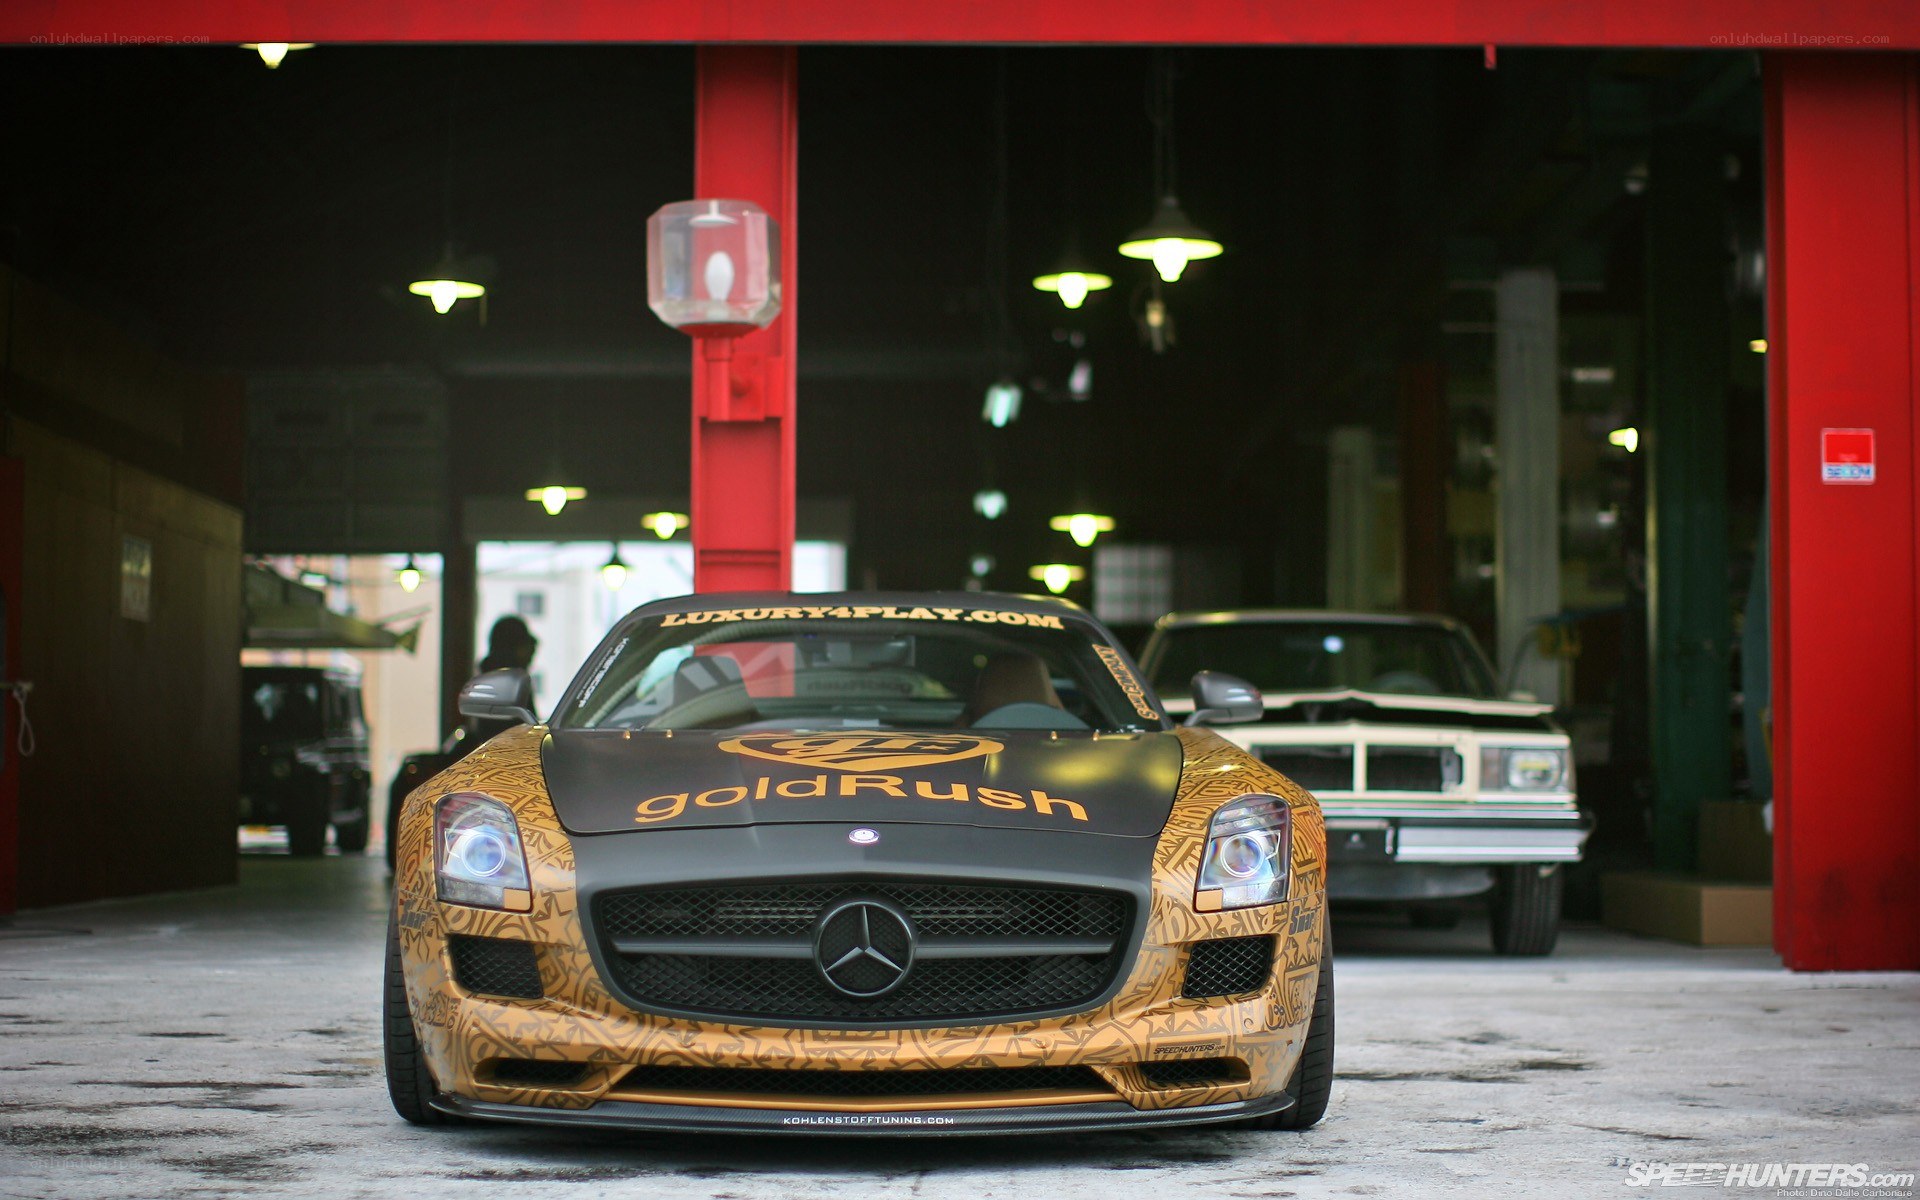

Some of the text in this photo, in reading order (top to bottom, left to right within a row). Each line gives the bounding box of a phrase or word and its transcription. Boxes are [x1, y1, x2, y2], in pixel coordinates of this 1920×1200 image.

[660, 606, 1065, 630] LUXURY4PLAY.COM
[634, 774, 1089, 823] goldRush
[783, 1116, 954, 1125] KOHLENSTOFFTUNING.COM
